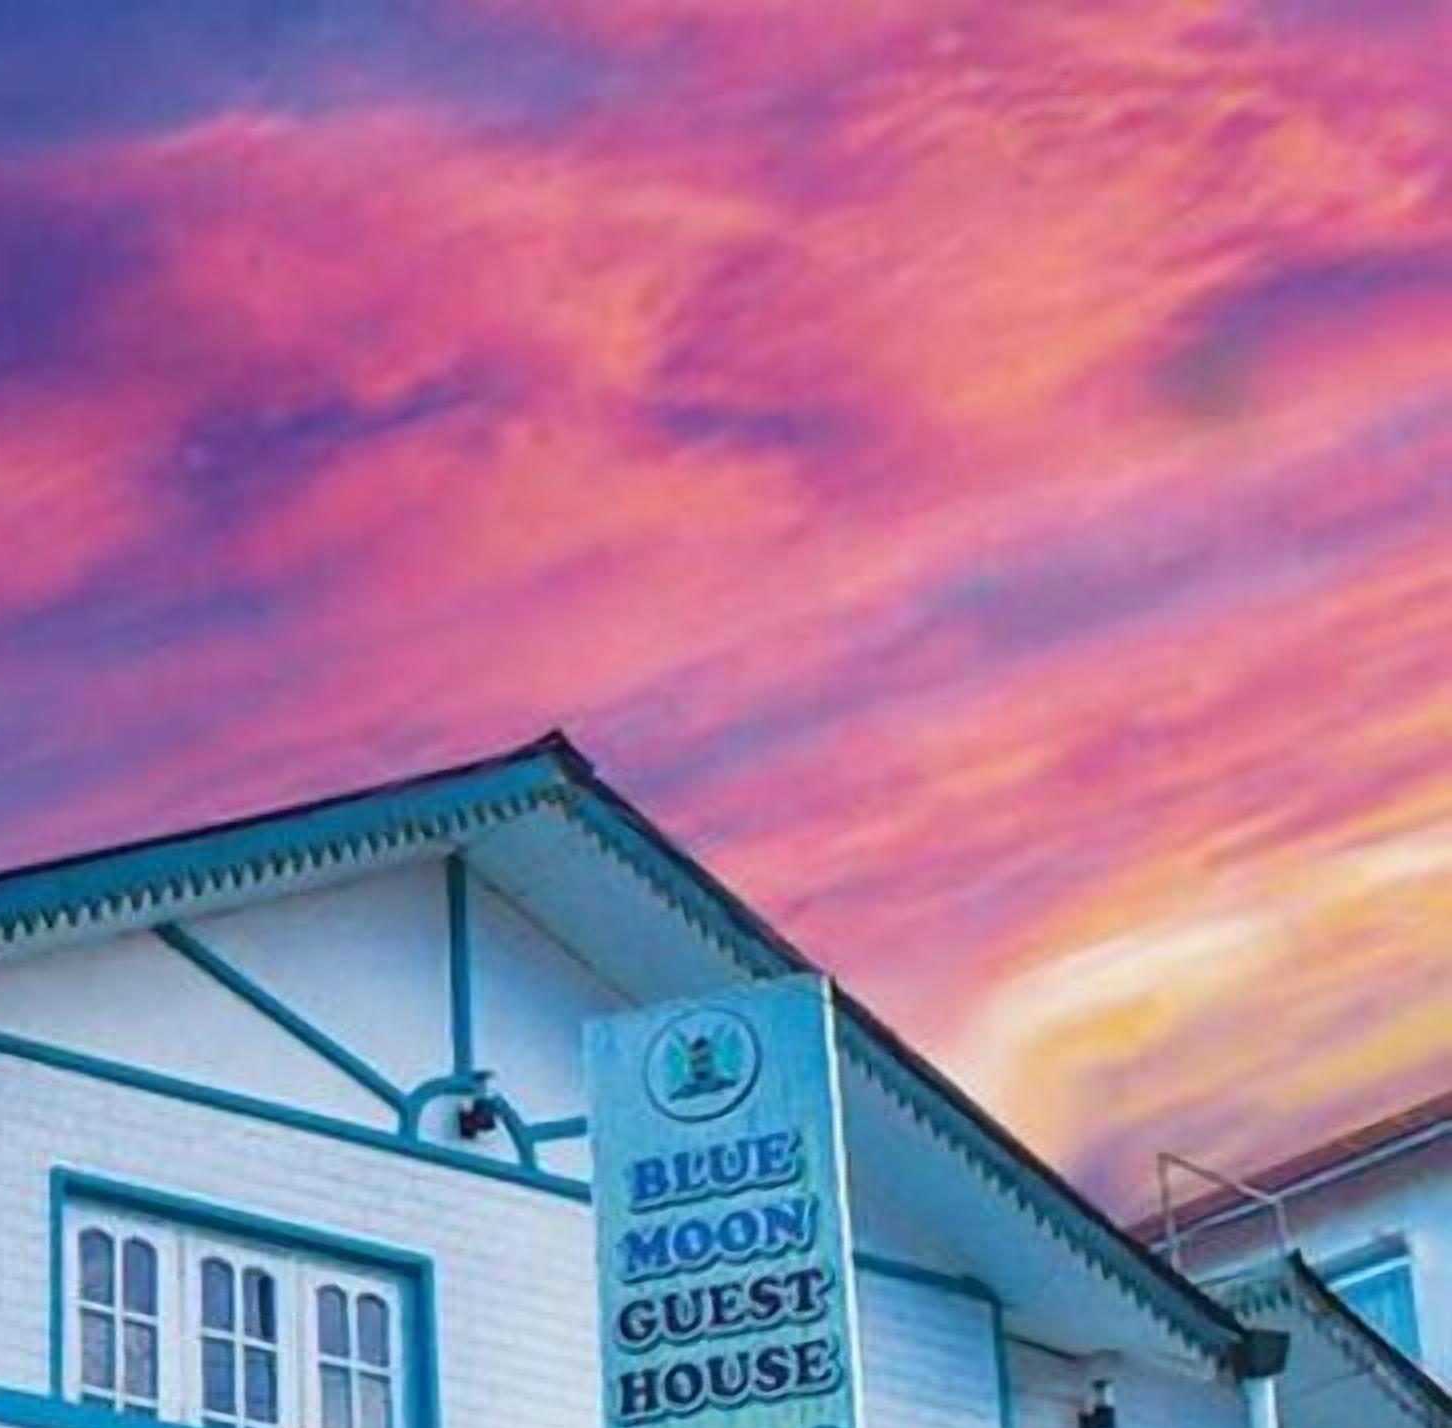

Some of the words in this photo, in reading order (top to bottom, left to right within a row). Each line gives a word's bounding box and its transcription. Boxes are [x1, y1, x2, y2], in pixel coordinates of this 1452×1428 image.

[631, 1130, 798, 1204] BLUE
[618, 1197, 814, 1275] MOON
[619, 1266, 826, 1342] GUEST
[619, 1338, 834, 1417] HOUSE
